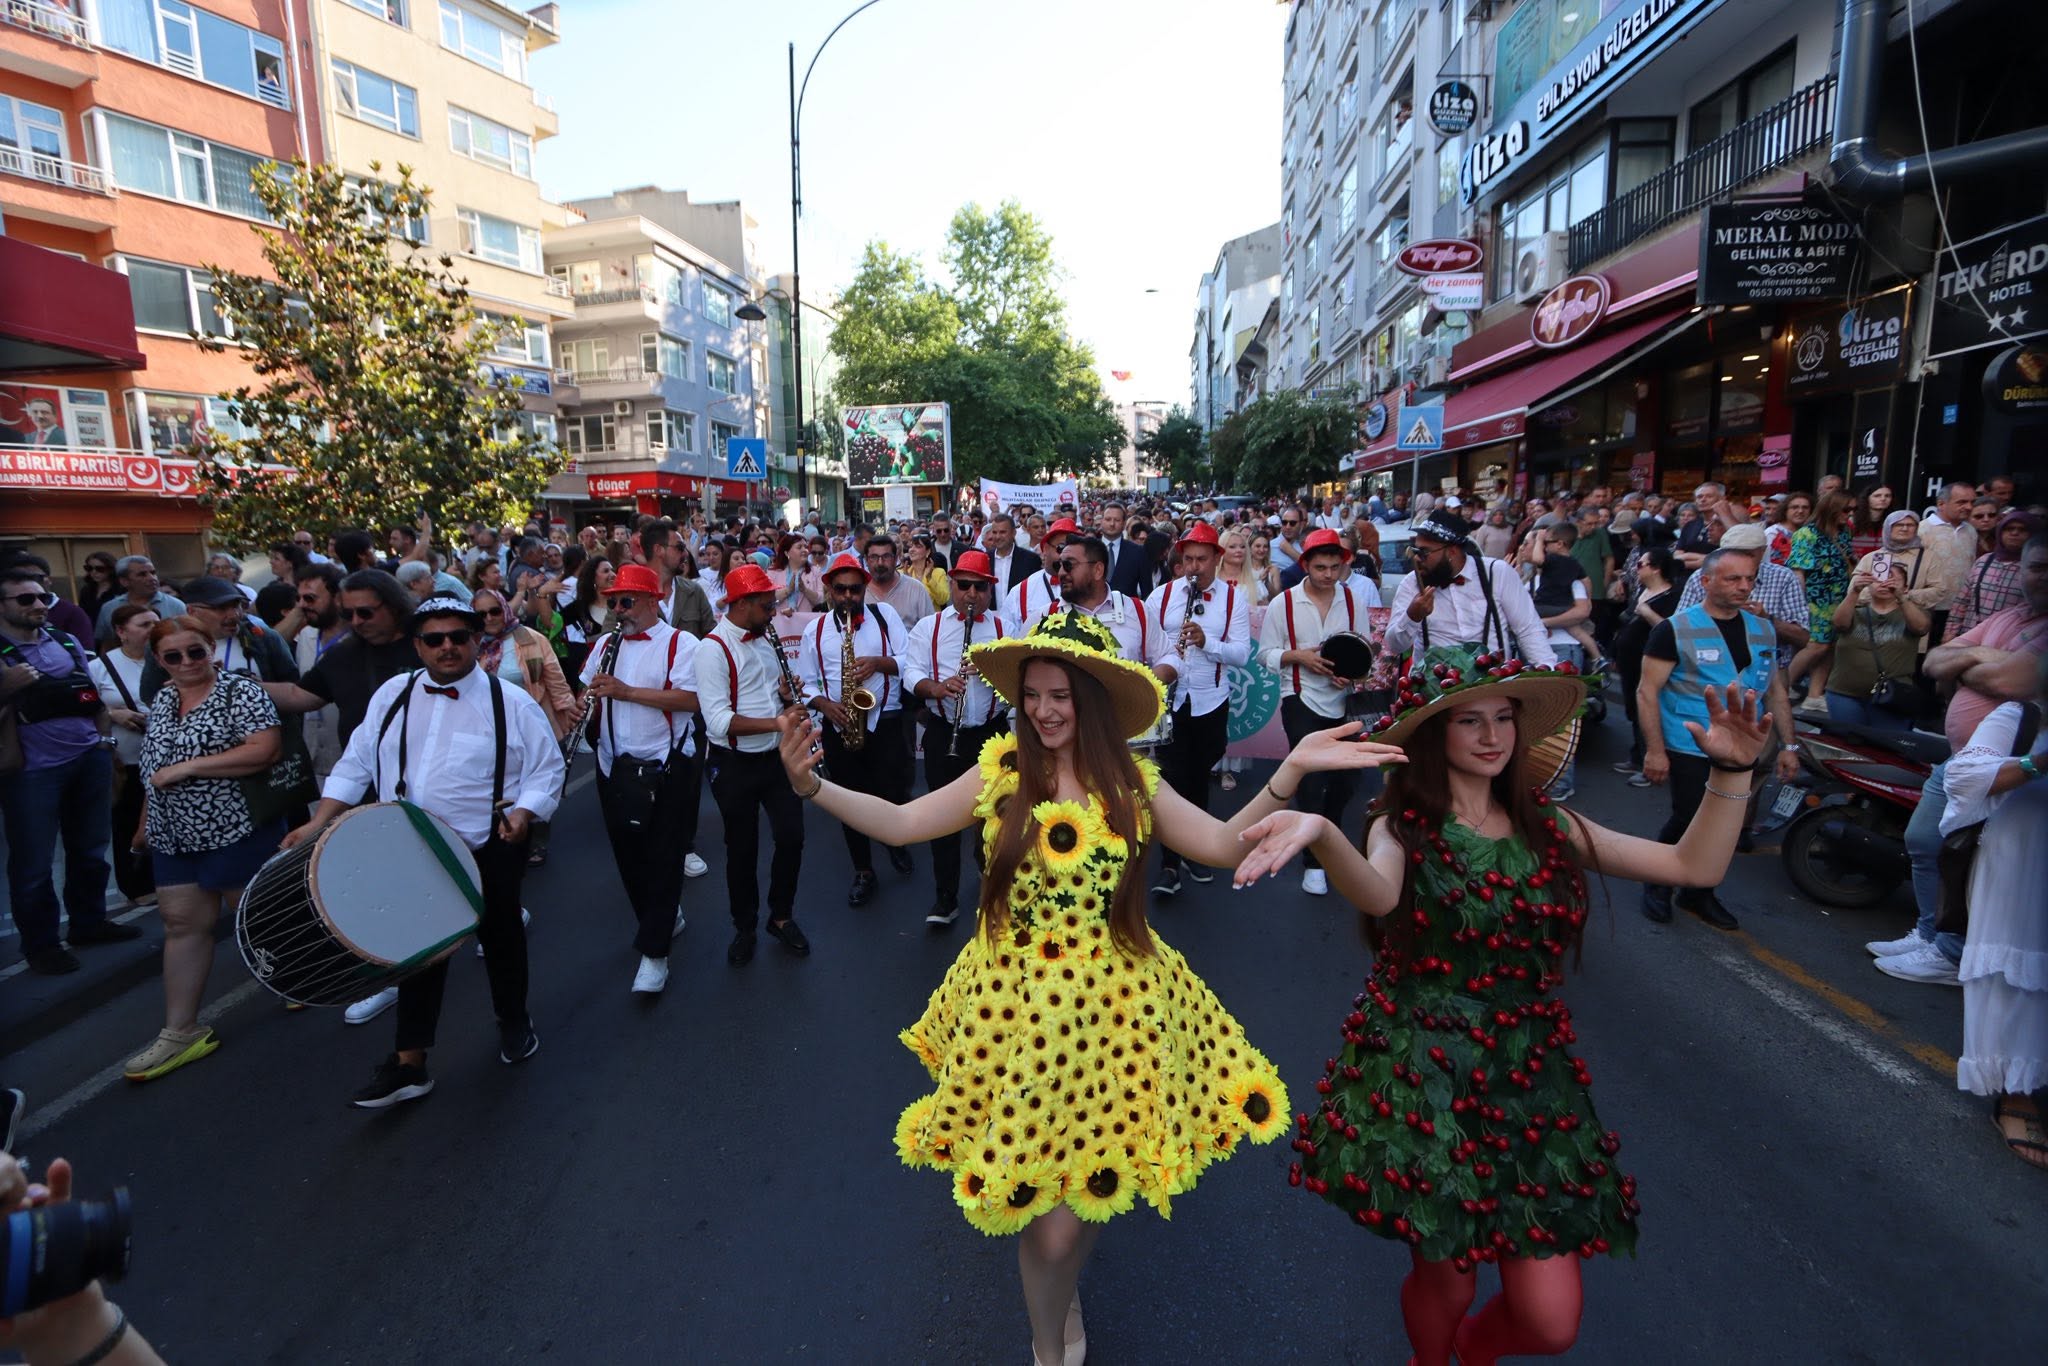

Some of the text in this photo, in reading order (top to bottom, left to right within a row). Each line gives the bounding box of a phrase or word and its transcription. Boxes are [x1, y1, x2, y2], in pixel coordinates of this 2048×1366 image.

[1715, 223, 1864, 246] MERAL MODA
[1731, 243, 1846, 261] GELİNLİK & ABİYE
[1427, 278, 1484, 287] Her zaman
[1737, 276, 1835, 288] www.meralmoda.com
[1988, 281, 2032, 304] HOTEL
[1840, 335, 1899, 359] GÜZELLİK
[1849, 347, 1899, 368] SALONU
[16, 453, 68, 471] BİRLİK
[70, 456, 124, 474] PARTİSİ
[45, 473, 69, 487] İLÇE
[70, 475, 128, 488] BAŞKANLIĞI
[597, 479, 631, 491] döner
